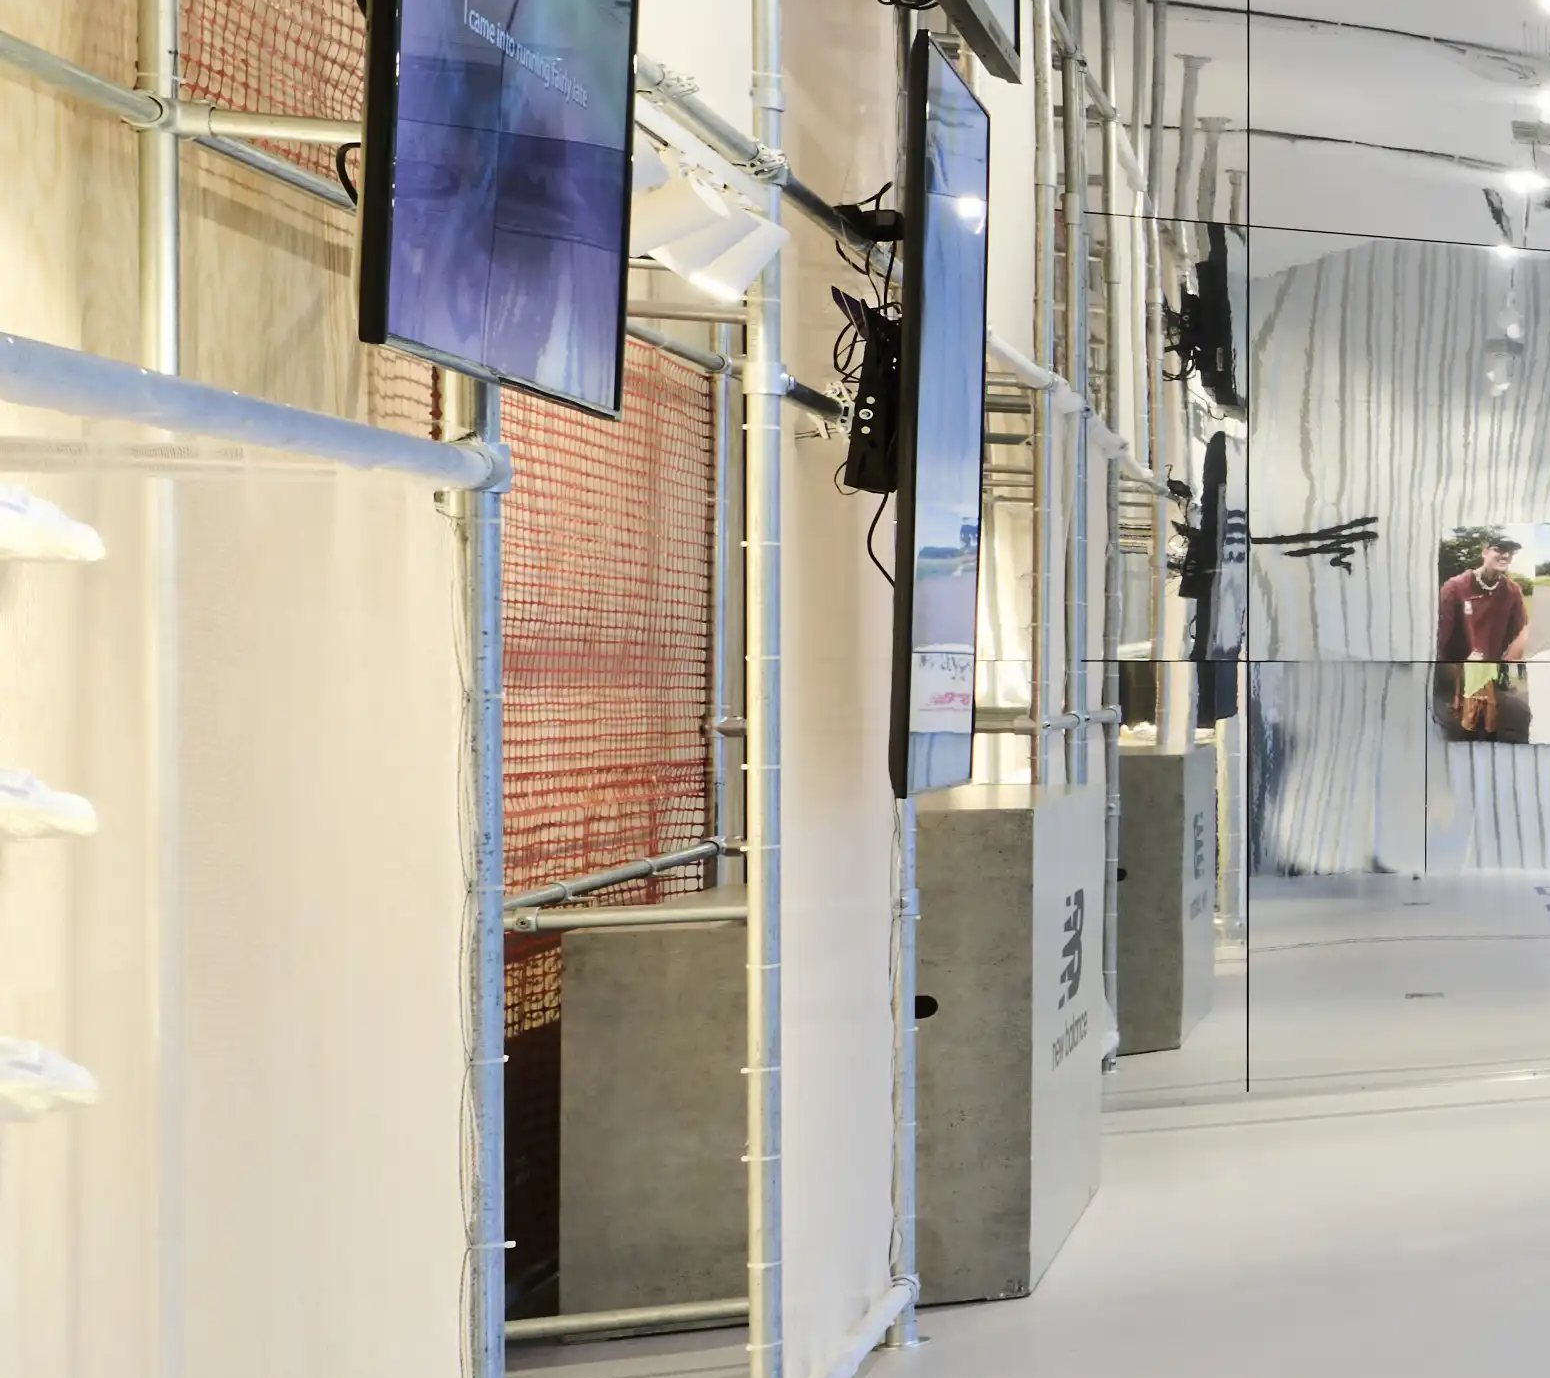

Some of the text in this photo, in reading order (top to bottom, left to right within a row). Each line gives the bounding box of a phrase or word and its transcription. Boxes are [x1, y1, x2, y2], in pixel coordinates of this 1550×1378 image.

[468, 9, 496, 45] came
[496, 22, 515, 58] into
[516, 44, 550, 91] running
[551, 62, 573, 103] fairly
[572, 77, 588, 110] late
[1051, 1009, 1089, 1072] new balance
